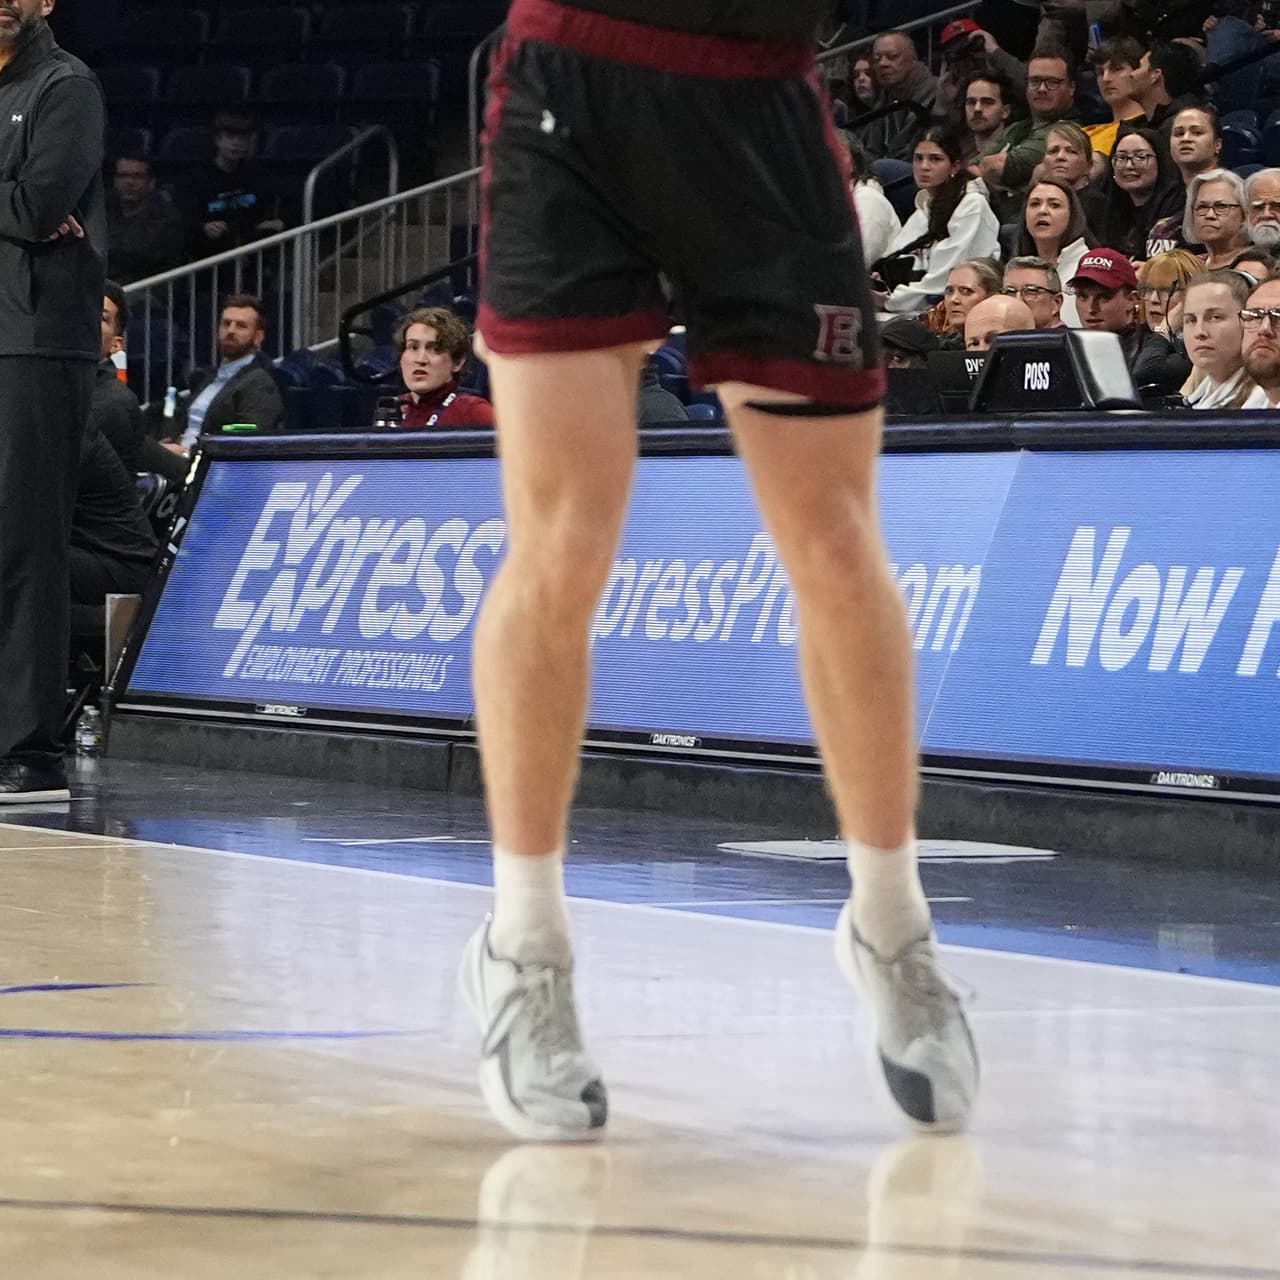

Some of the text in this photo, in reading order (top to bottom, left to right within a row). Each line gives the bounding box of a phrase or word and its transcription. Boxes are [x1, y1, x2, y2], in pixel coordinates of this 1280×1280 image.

[813, 304, 865, 368] E
[1024, 362, 1051, 390] POSS
[1030, 526, 1246, 672] Now
[1157, 771, 1215, 789] DAKTRONICS
